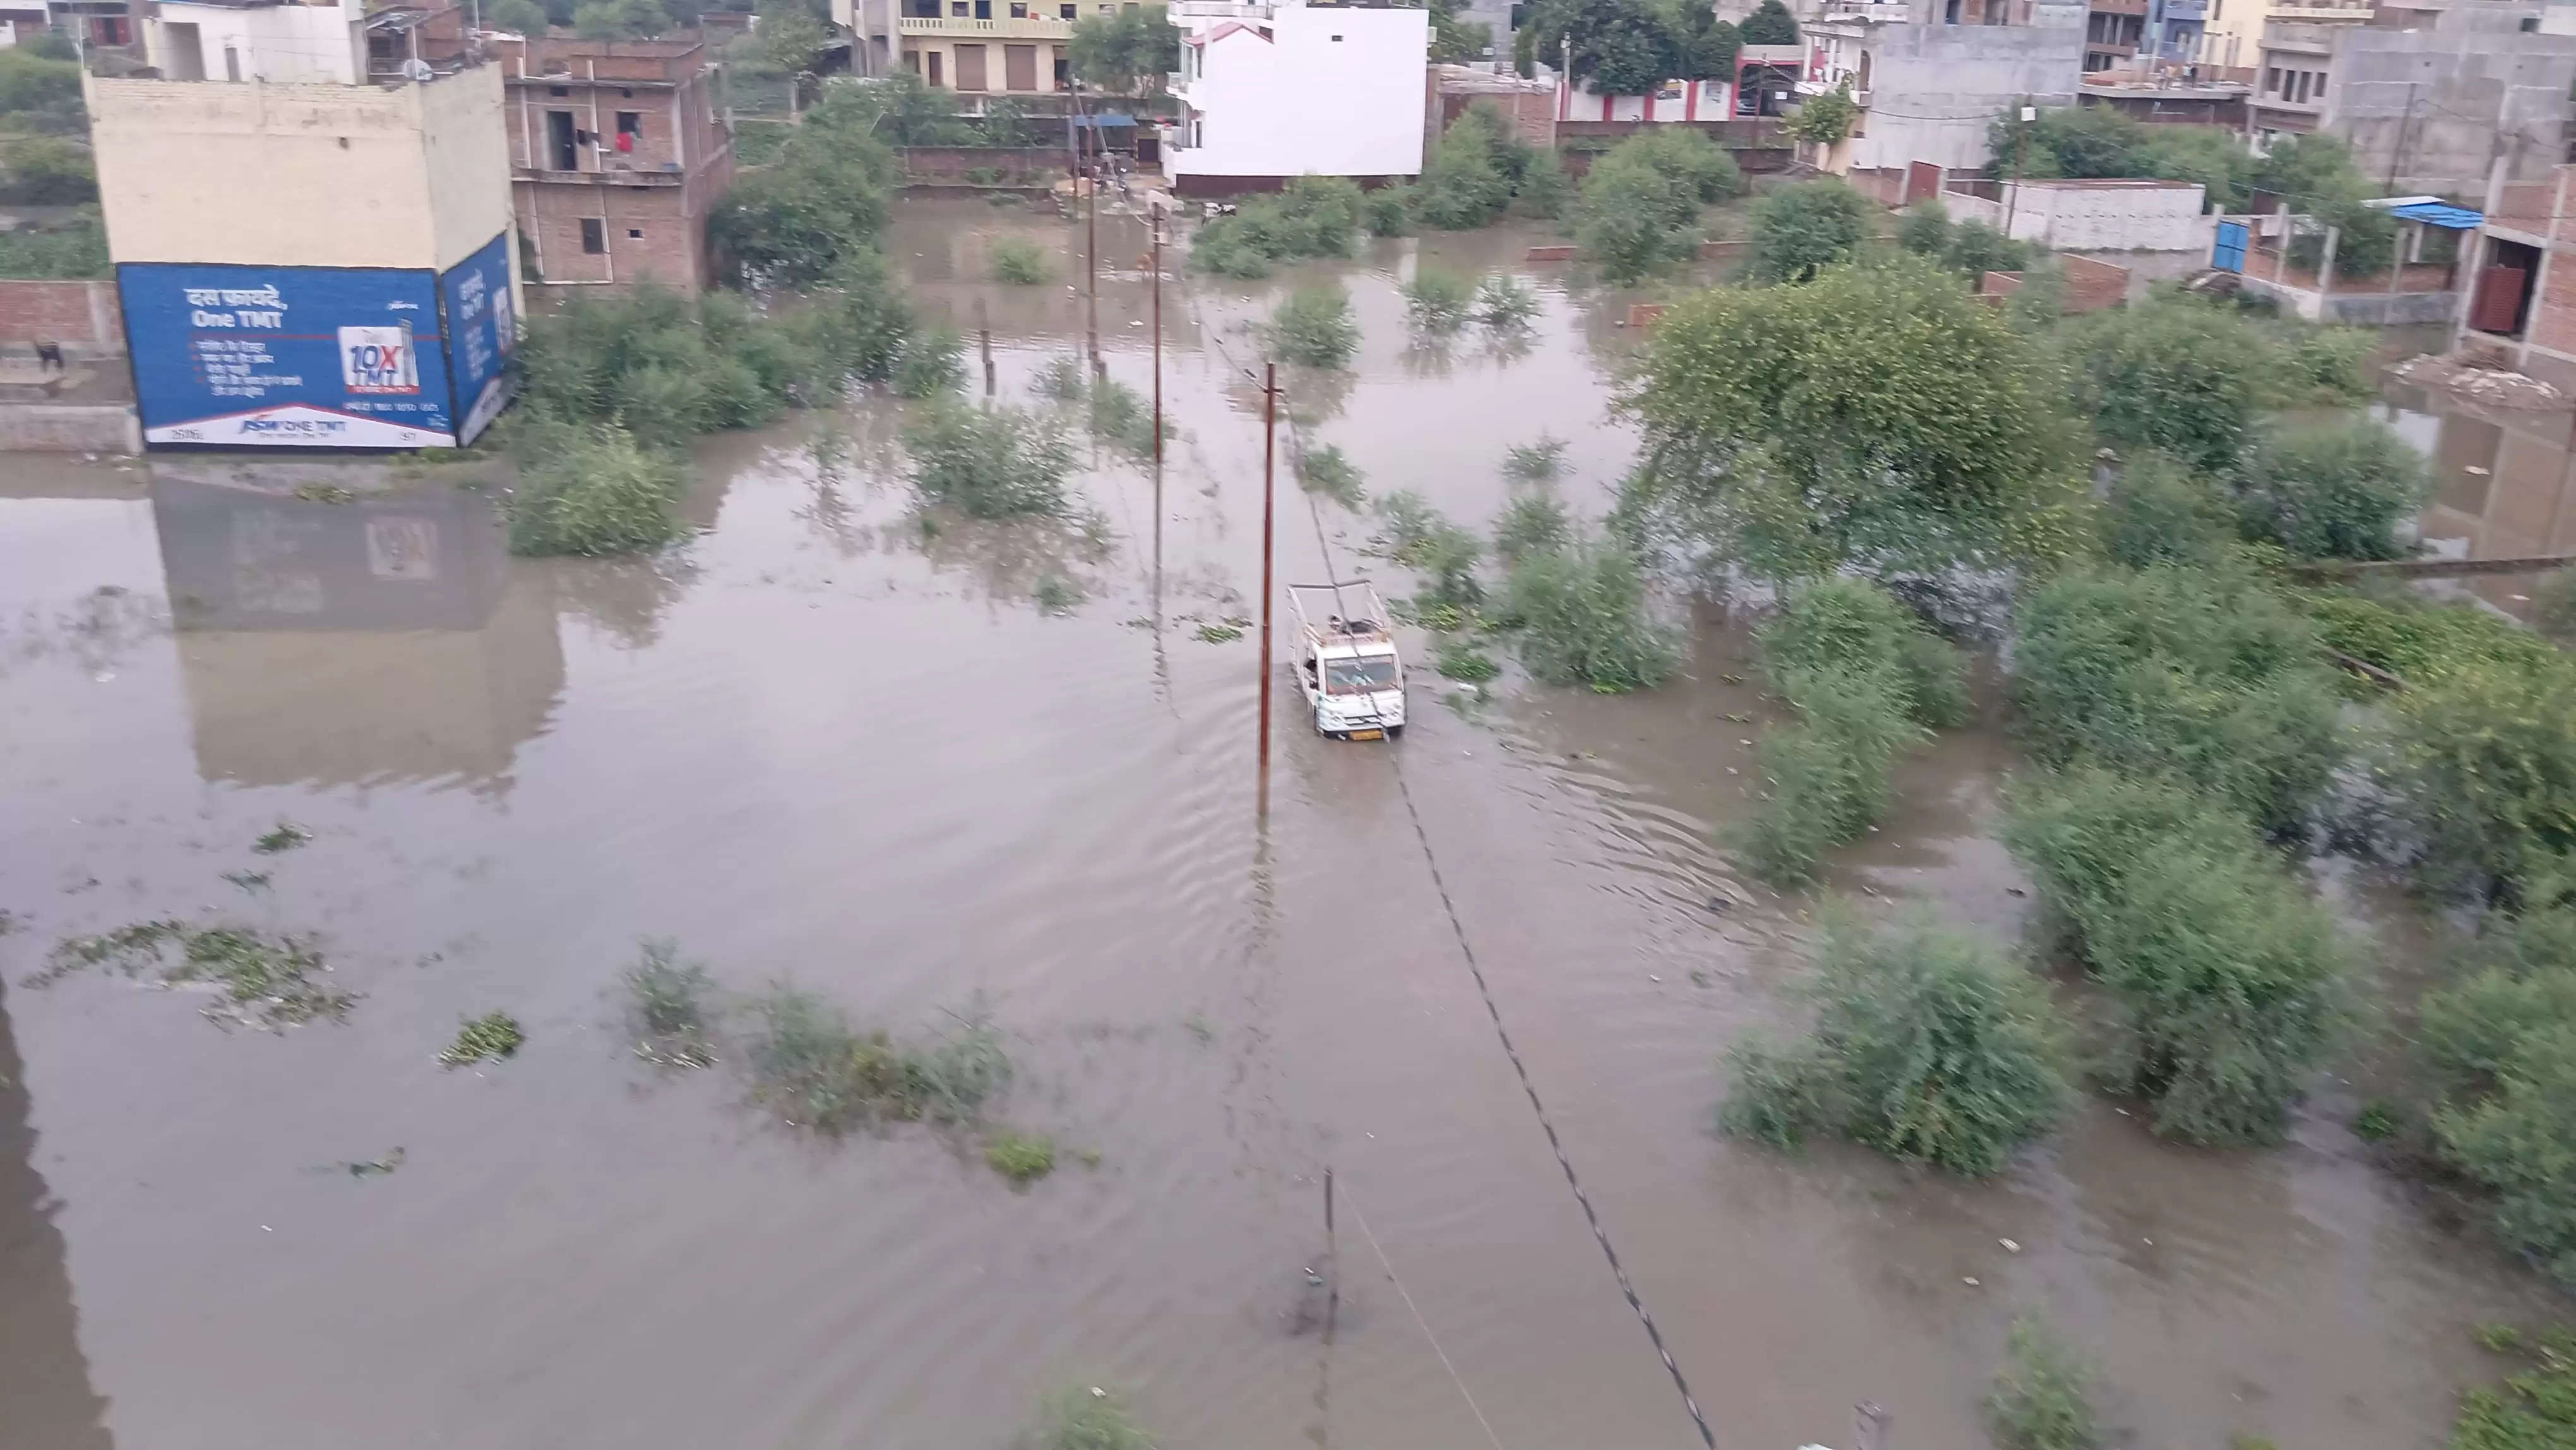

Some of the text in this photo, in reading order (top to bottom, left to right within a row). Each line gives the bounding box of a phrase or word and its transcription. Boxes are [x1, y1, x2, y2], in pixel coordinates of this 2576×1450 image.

[182, 289, 220, 307] दस
[191, 310, 283, 328] One TMT
[350, 345, 402, 371] 10X
[285, 420, 314, 431] ONE
